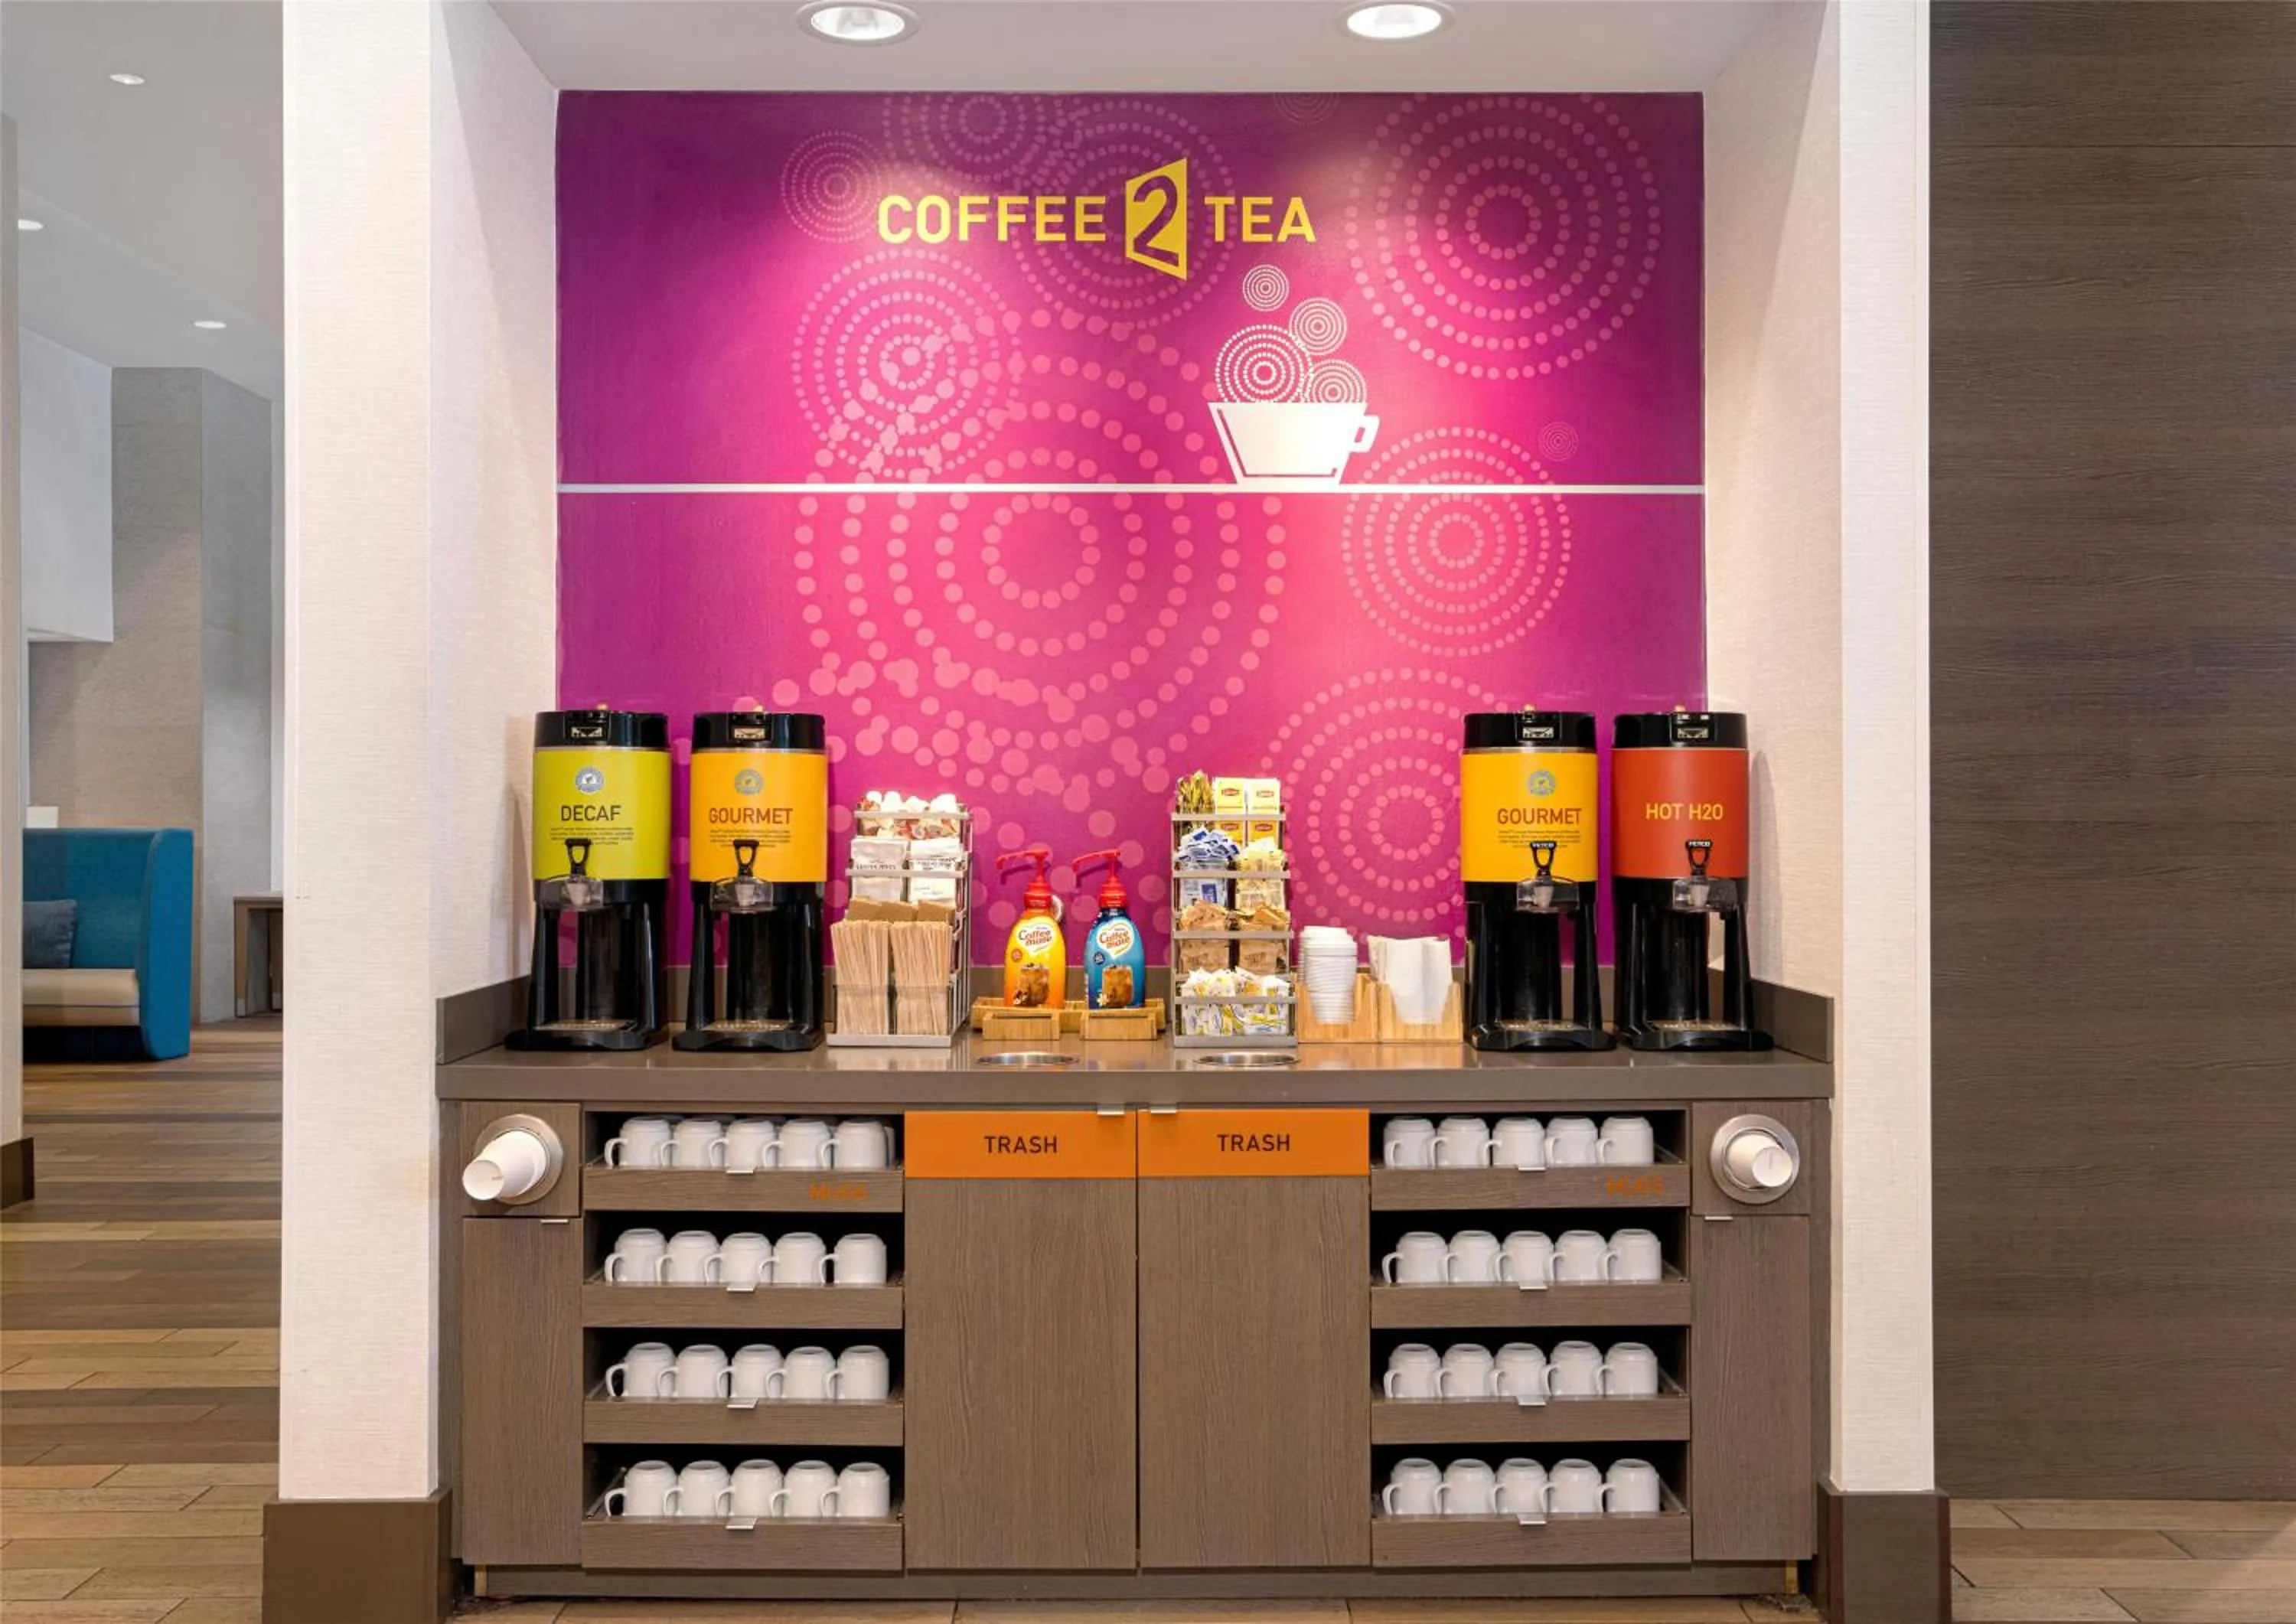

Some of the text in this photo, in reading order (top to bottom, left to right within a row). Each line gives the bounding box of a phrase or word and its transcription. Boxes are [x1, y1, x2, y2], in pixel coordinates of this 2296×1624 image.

[878, 174, 1316, 267] COFFEE 2 TEA
[561, 804, 621, 821] DECAF
[709, 807, 794, 824] GOURMET
[1497, 807, 1582, 824] GOURMET
[1645, 802, 1684, 820] HOT
[984, 1135, 1058, 1154] TRASH
[1217, 1133, 1291, 1153] TRASH
